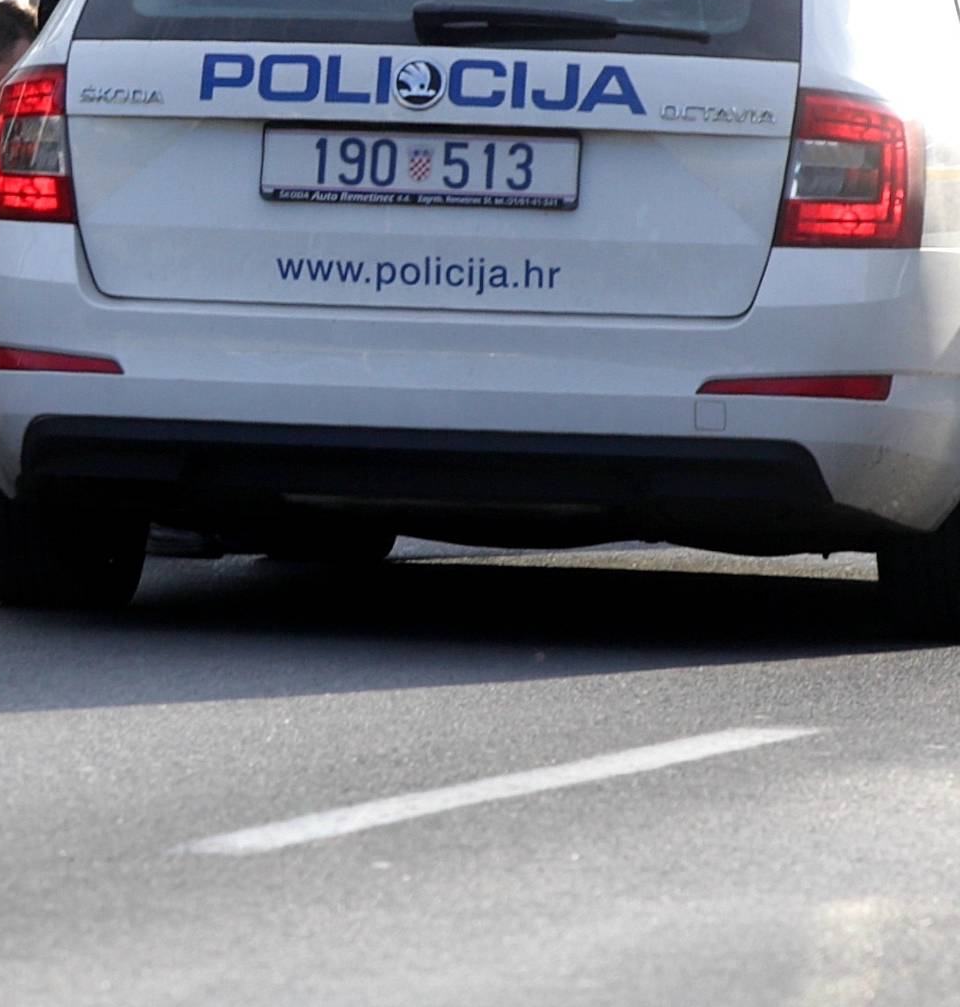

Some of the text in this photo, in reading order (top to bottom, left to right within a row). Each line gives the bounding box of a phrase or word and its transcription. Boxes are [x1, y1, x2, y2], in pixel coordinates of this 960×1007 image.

[660, 104, 777, 124] OCTAVIA
[315, 136, 535, 192] 190 513
[311, 190, 338, 201] Auto
[277, 256, 561, 294] www.policija.hr
